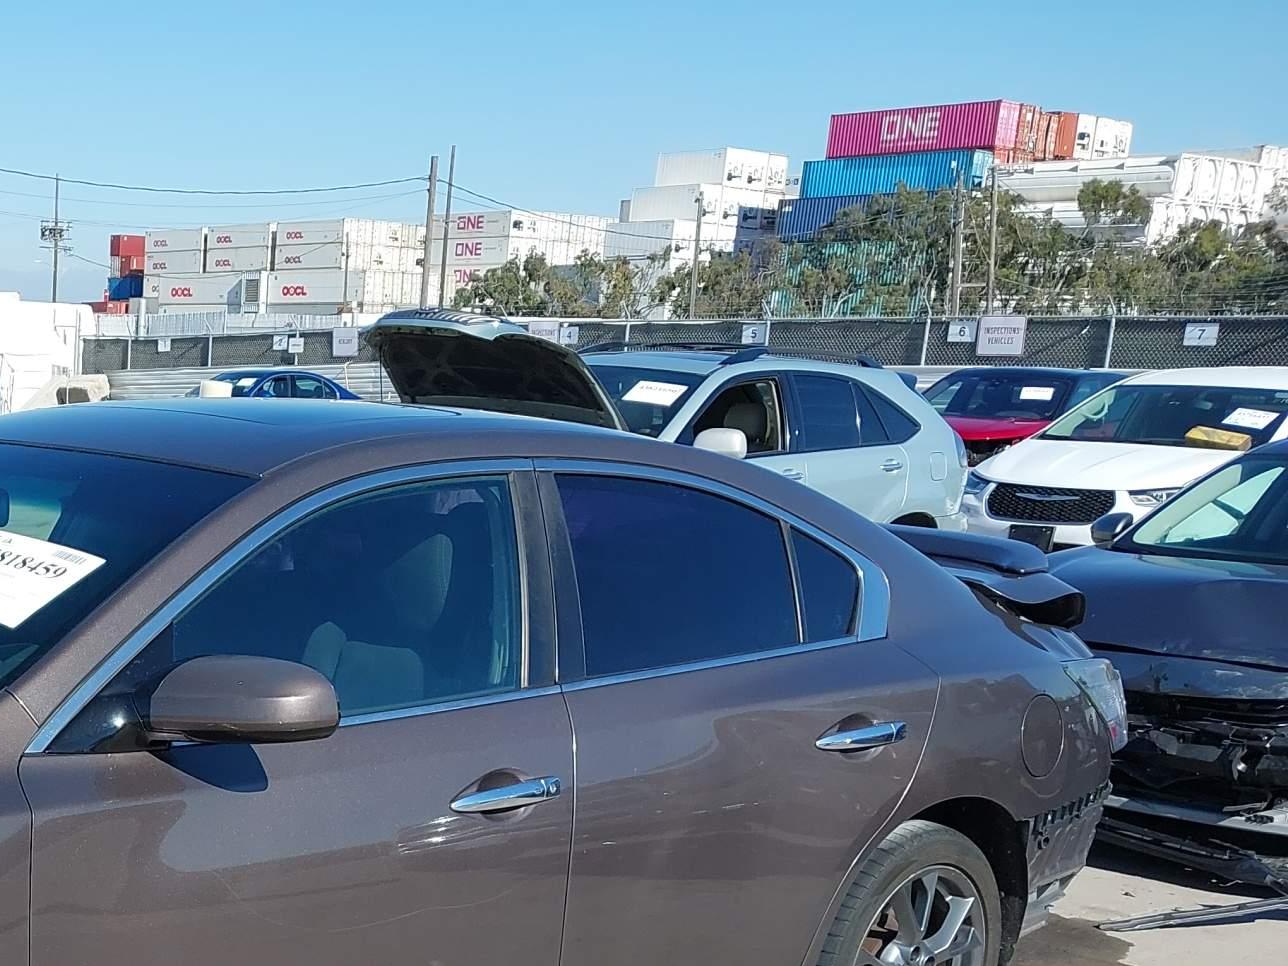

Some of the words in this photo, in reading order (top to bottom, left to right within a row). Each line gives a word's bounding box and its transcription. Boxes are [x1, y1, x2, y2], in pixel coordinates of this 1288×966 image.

[880, 112, 940, 140] ONE
[457, 215, 484, 230] ONE
[455, 242, 482, 256] ONE
[171, 287, 192, 297] OOCL
[281, 286, 307, 296] OOCL
[566, 331, 572, 340] 4
[751, 329, 757, 339] 5
[959, 326, 965, 336] 6
[1198, 329, 1206, 340] 7
